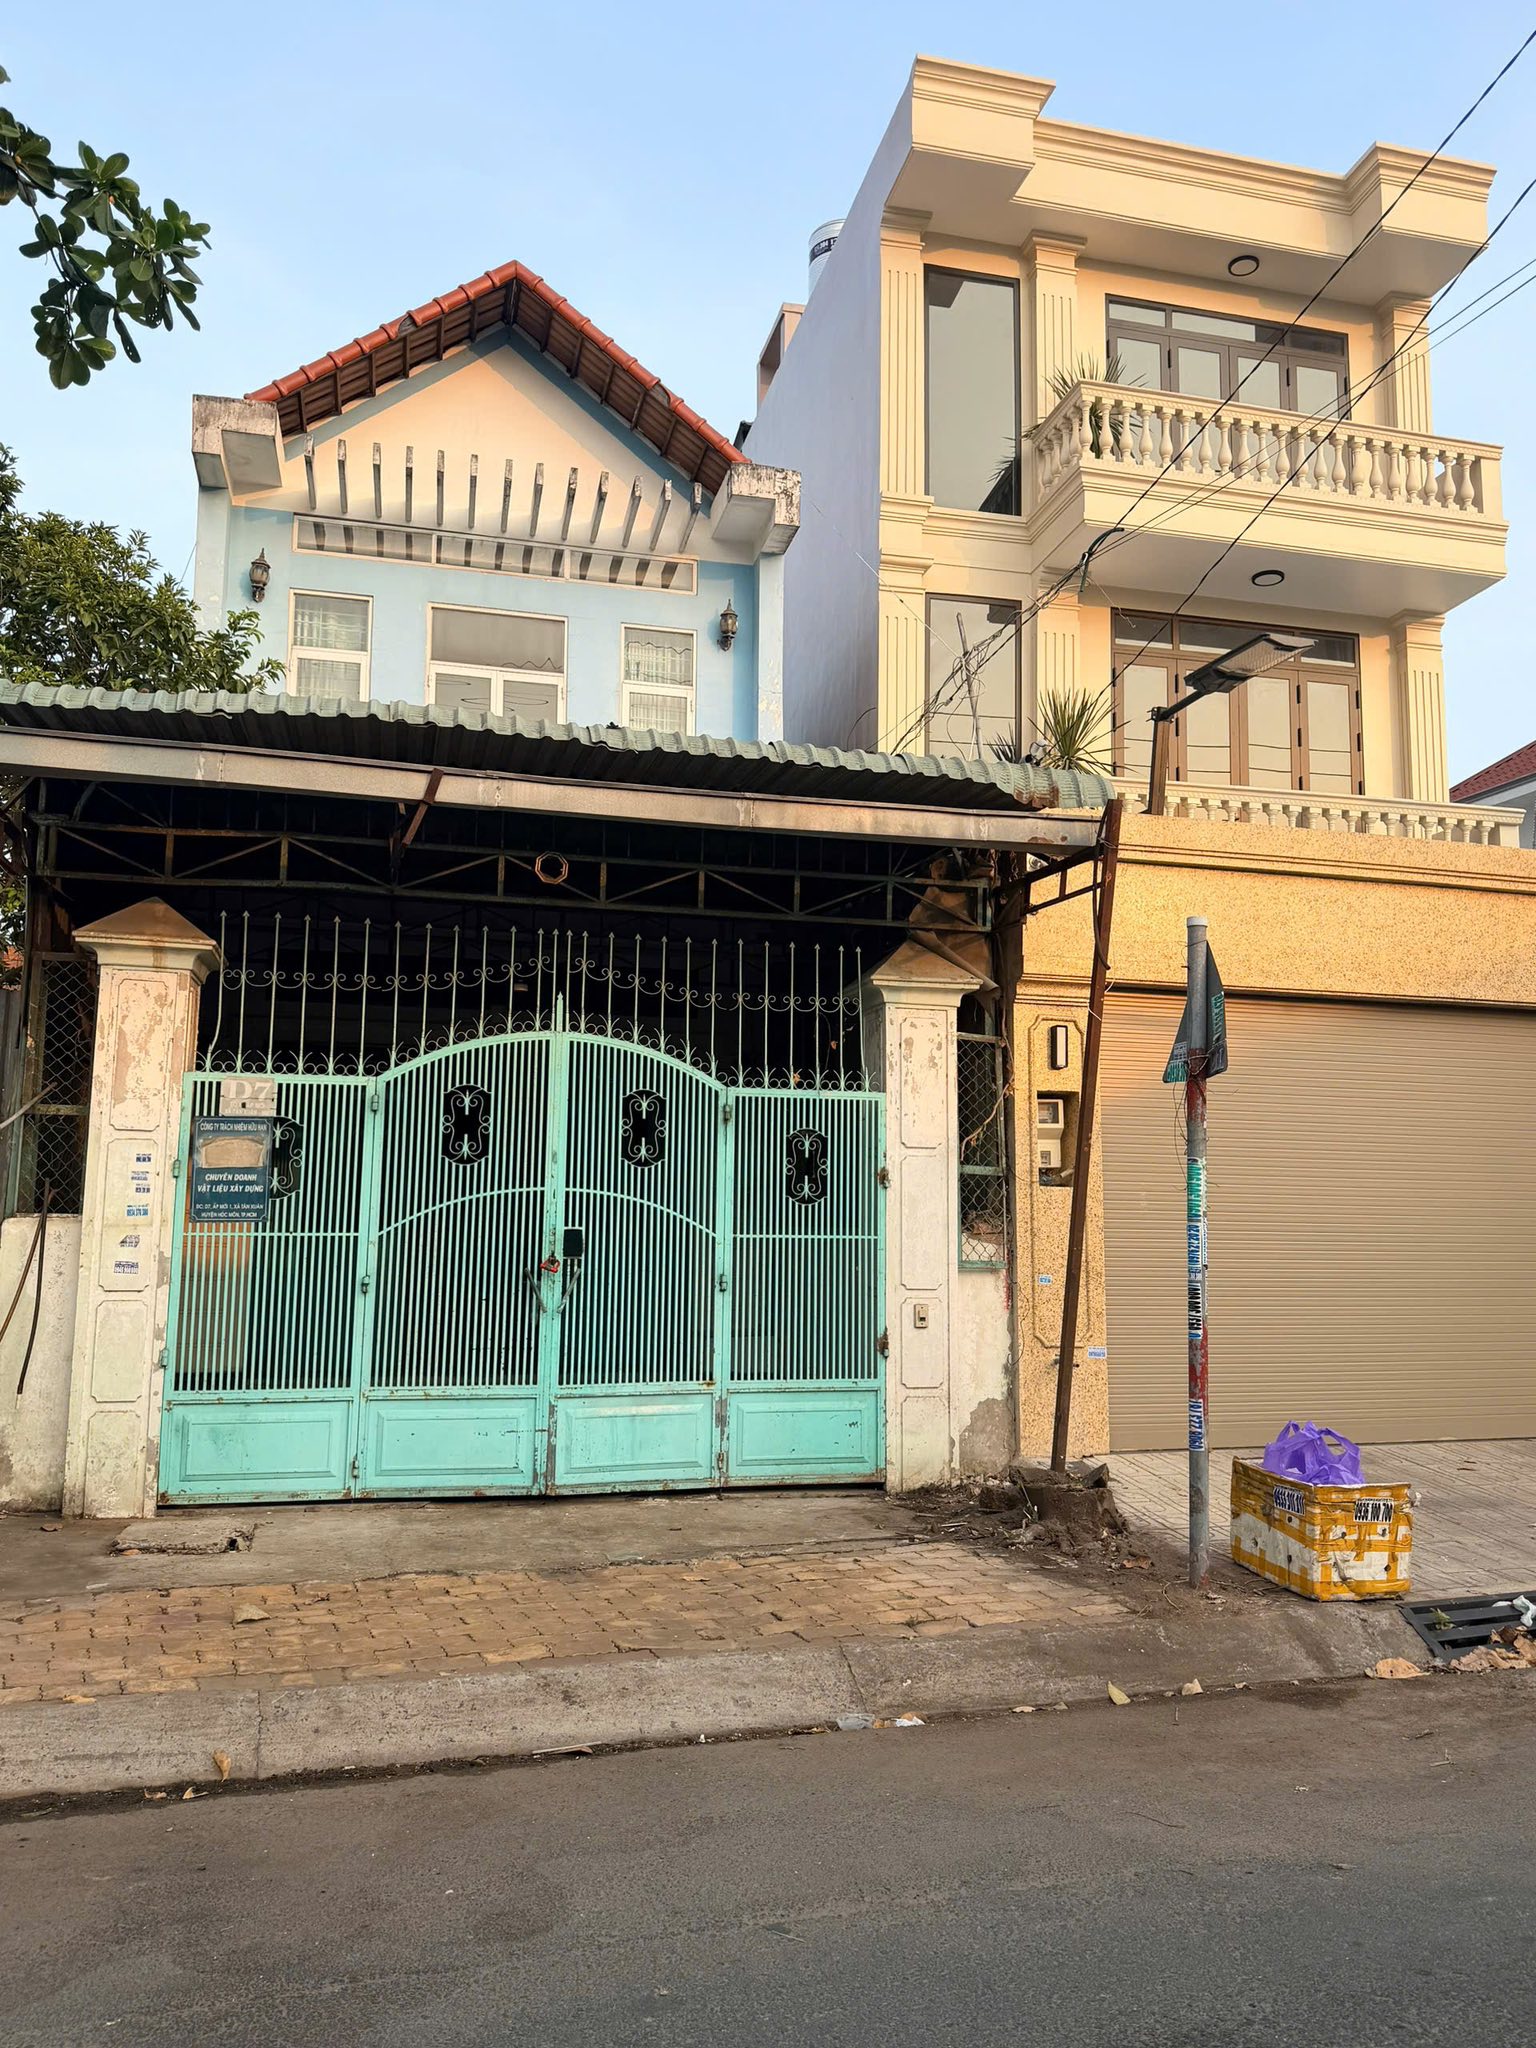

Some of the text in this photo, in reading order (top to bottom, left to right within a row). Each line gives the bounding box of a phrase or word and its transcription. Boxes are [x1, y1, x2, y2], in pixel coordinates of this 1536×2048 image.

[229, 1080, 272, 1101] D7
[205, 1172, 258, 1181] CHUYÊN DOANH
[197, 1183, 264, 1194] VẬT LIỆU XÂY DỰNG
